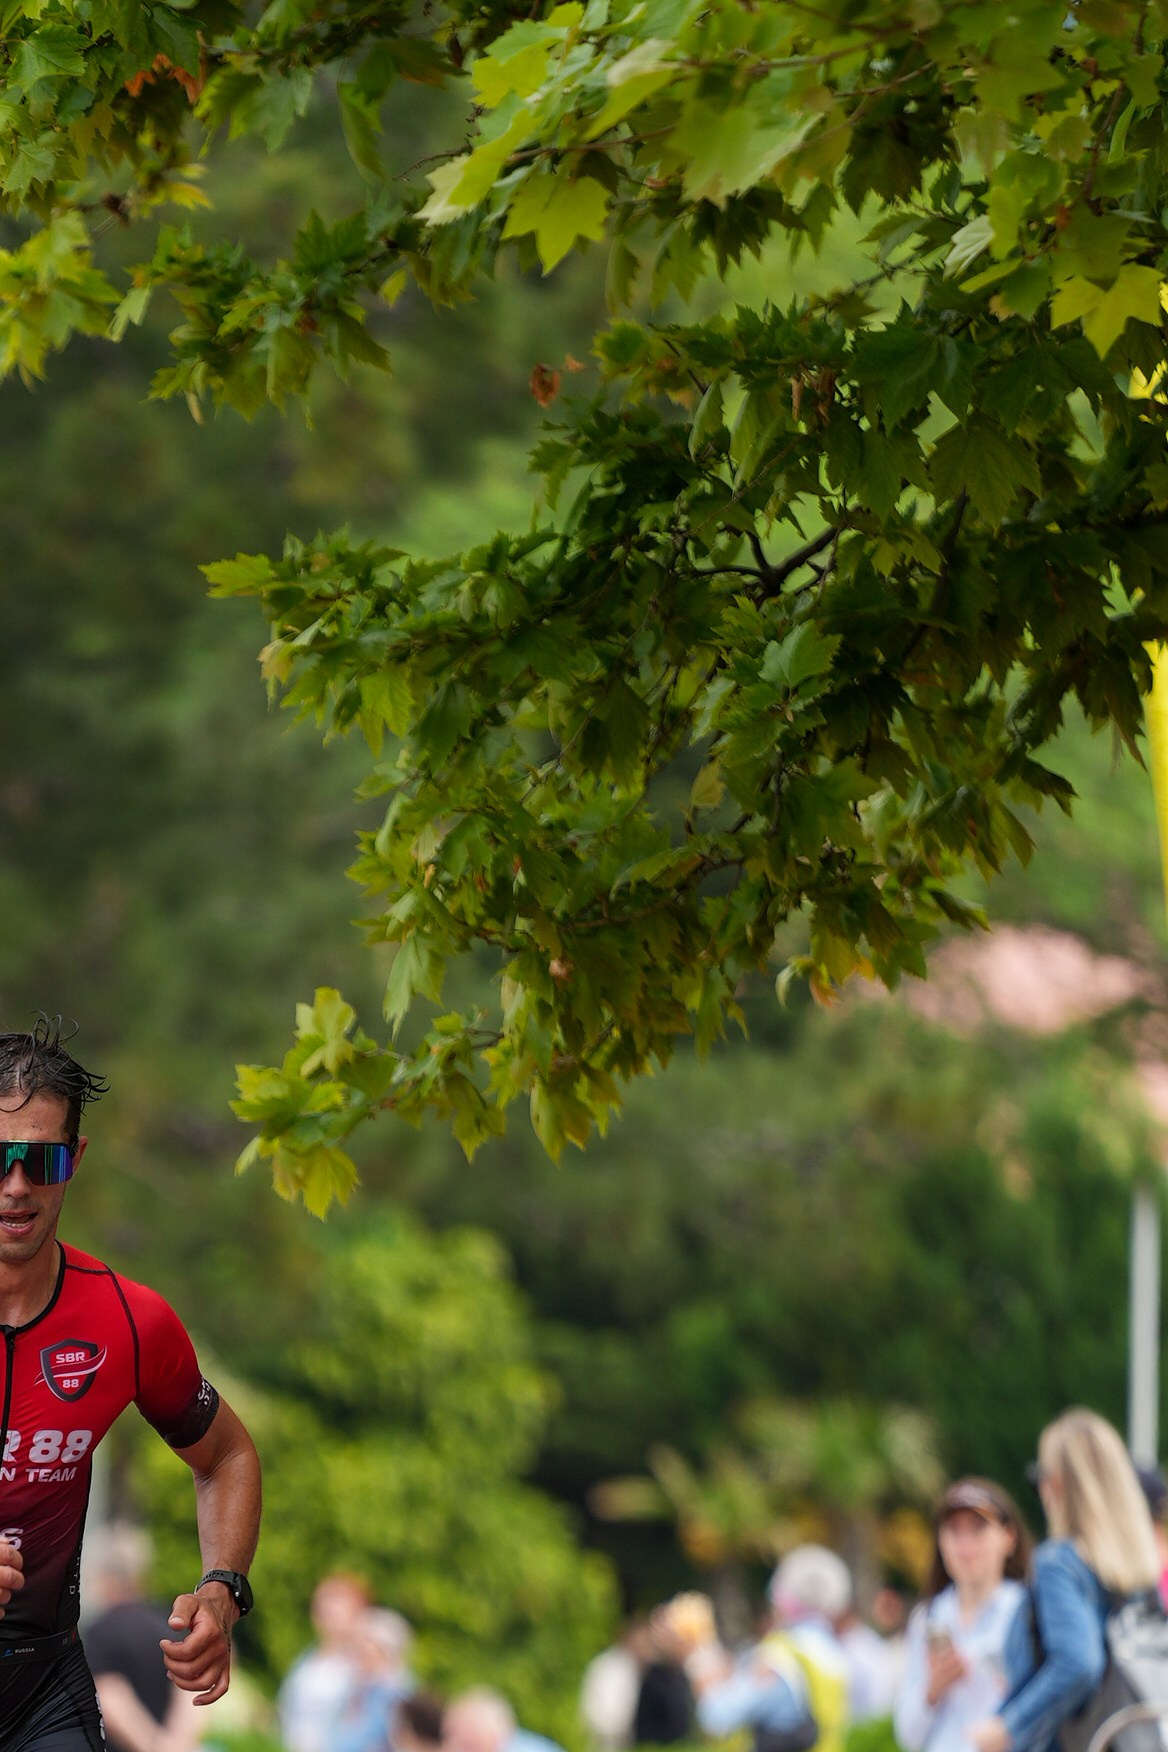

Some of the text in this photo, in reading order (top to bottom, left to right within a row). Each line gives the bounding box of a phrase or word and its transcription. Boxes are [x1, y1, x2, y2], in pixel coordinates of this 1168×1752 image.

[56, 1351, 86, 1364] SBR
[62, 1378, 80, 1389] 88
[28, 1429, 93, 1464] 88
[25, 1466, 78, 1483] TEAM
